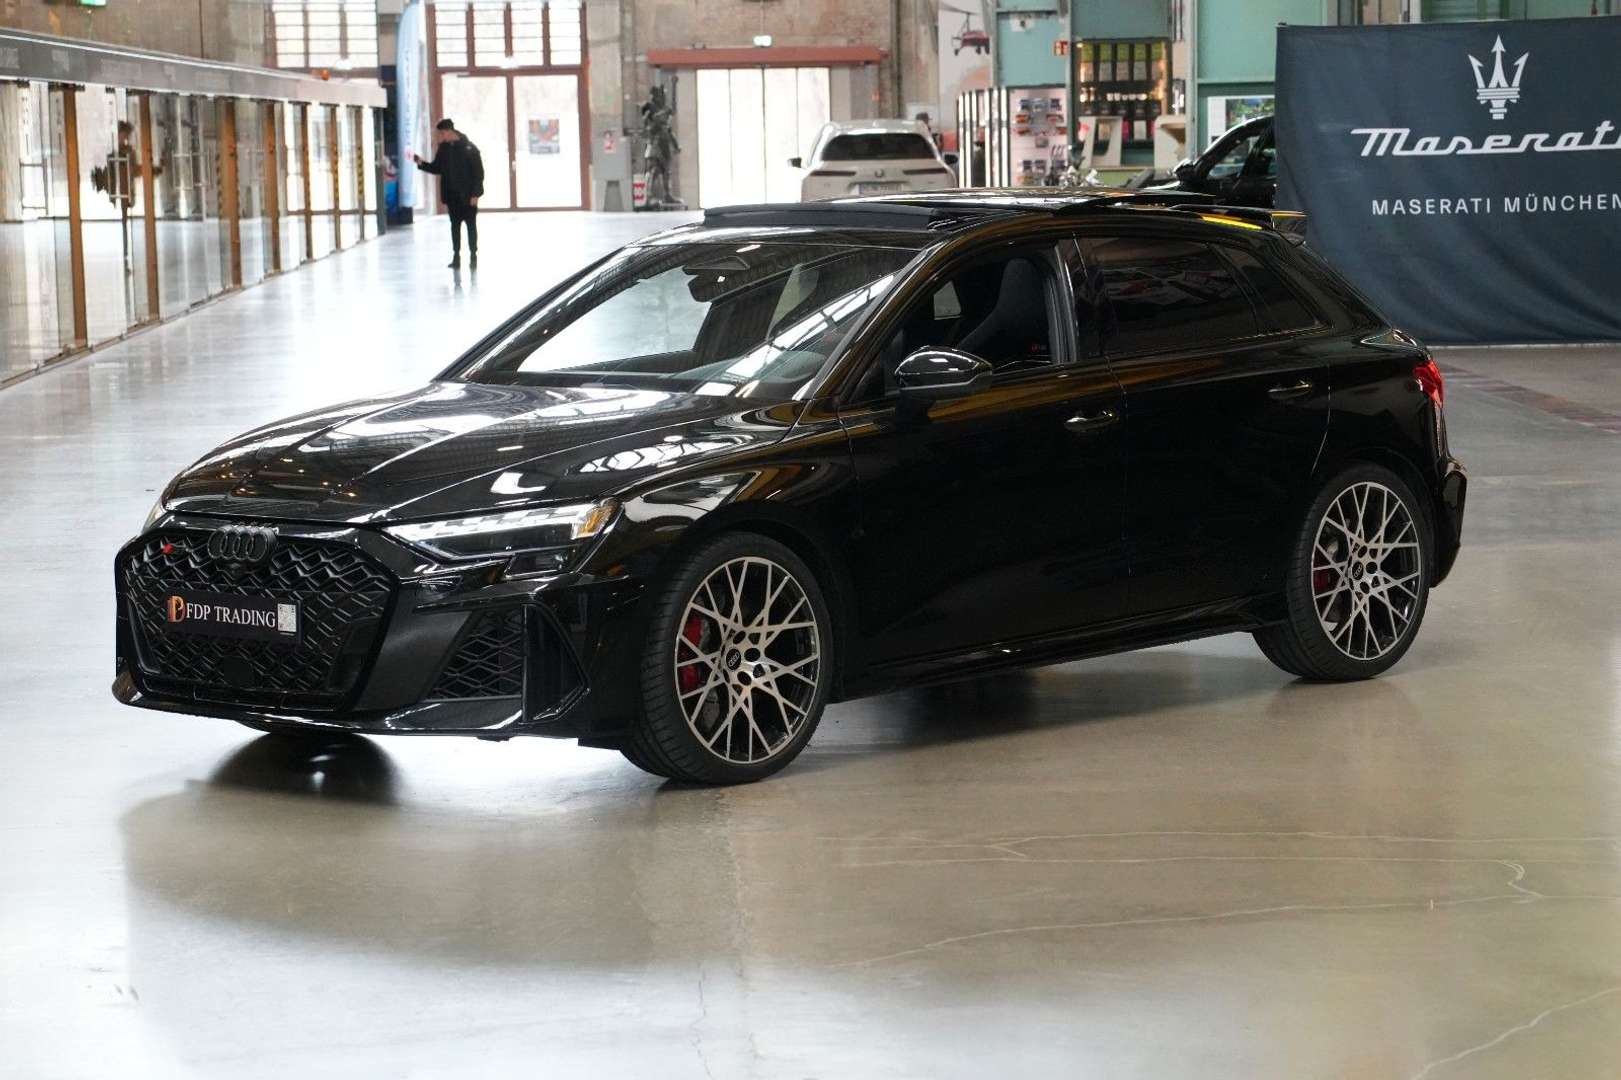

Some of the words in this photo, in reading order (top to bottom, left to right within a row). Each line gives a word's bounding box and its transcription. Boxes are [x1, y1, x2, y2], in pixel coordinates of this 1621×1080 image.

[1372, 198, 1491, 216] MASERATI
[1504, 193, 1621, 214] MÜNCHEN
[186, 602, 211, 620] FDP
[213, 605, 276, 628] TRADING
